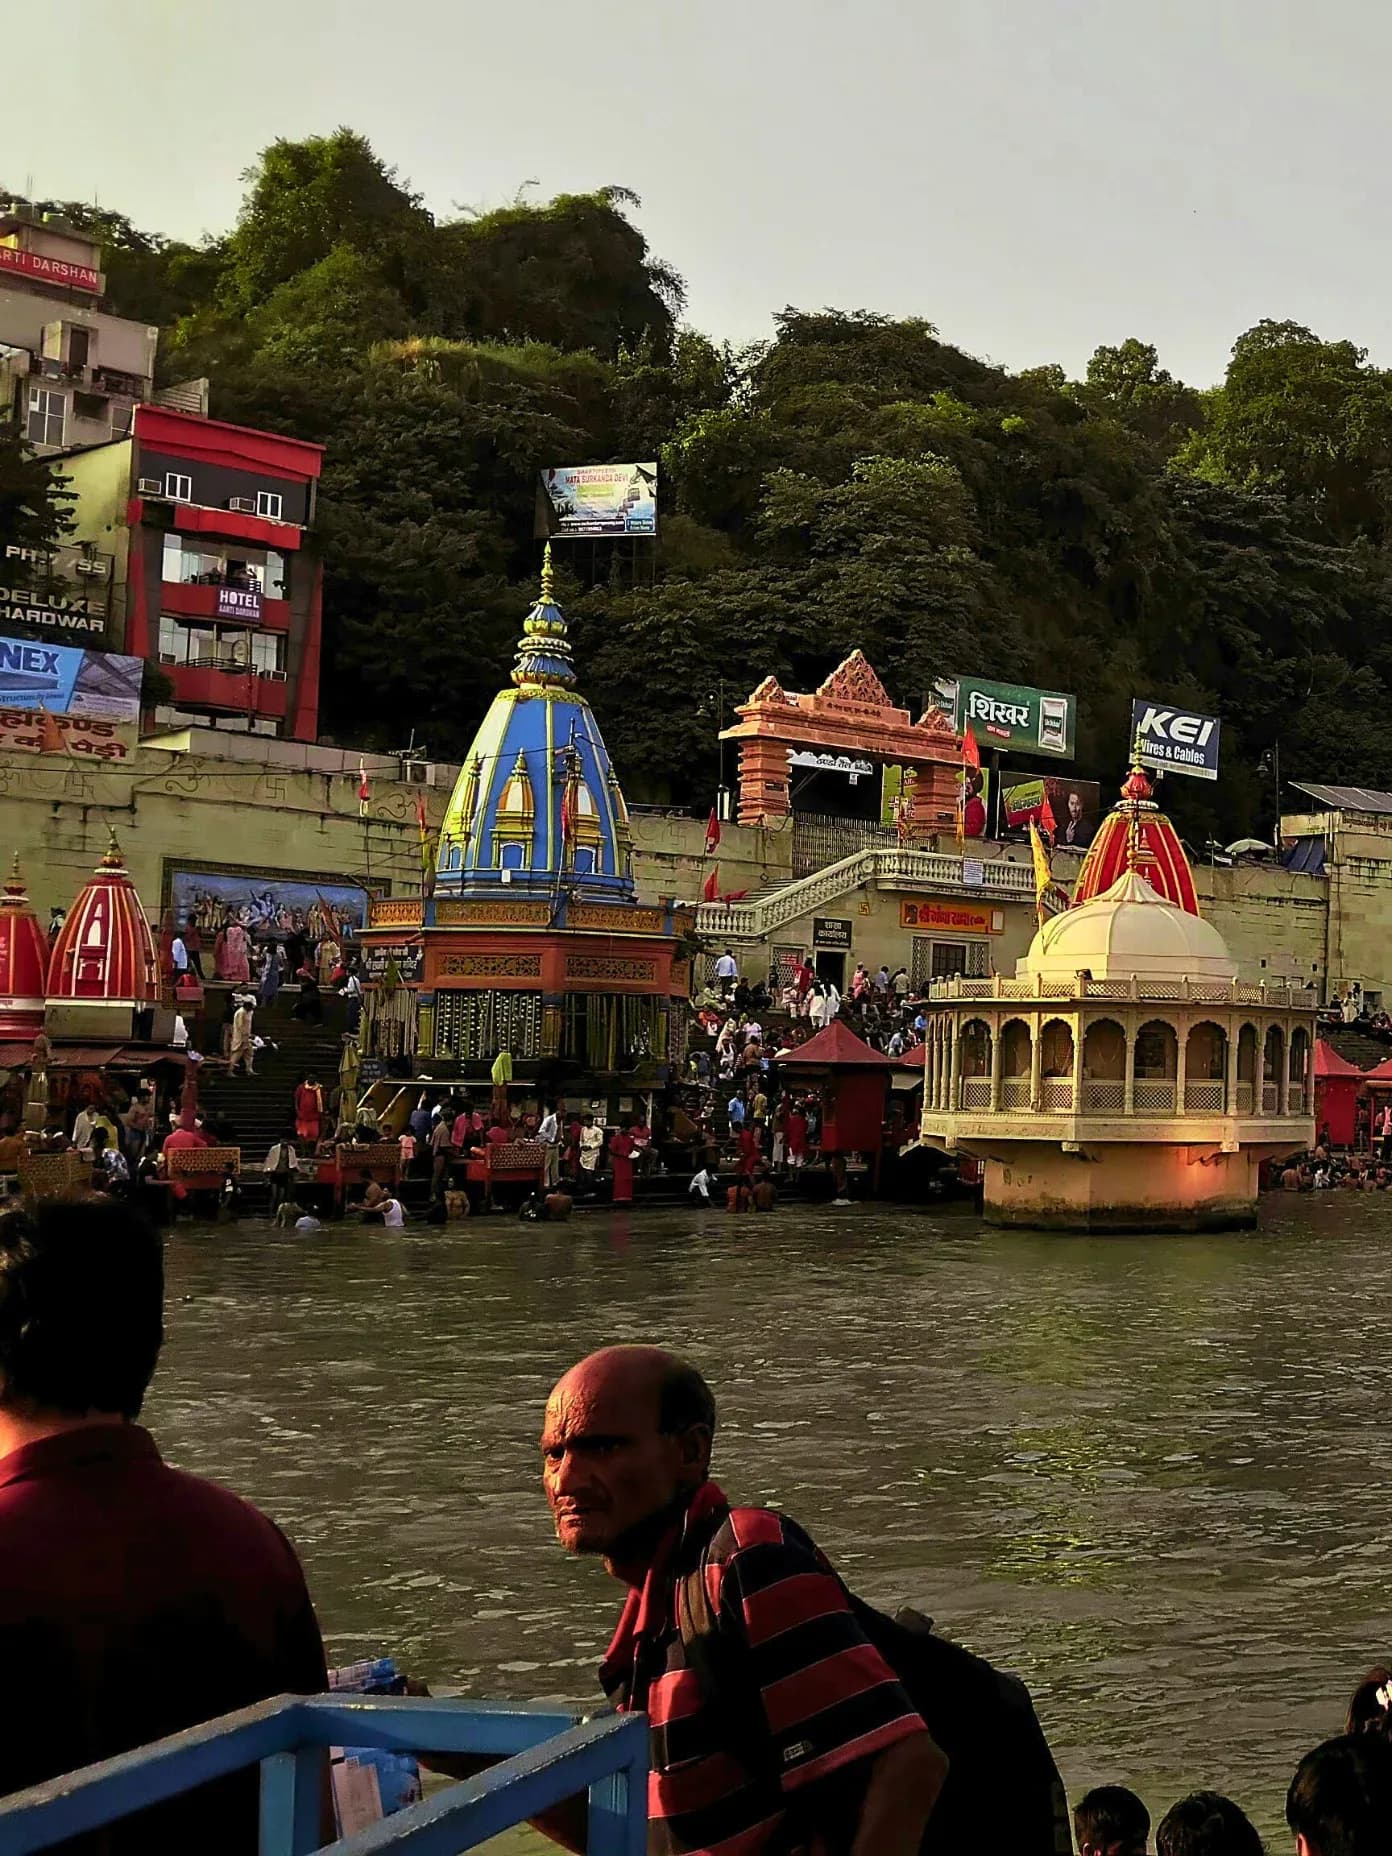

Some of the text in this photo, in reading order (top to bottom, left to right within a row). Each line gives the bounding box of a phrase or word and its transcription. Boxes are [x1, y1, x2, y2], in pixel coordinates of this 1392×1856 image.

[0, 248, 97, 284] RTI DARSHAN
[220, 590, 260, 608] HOTEL
[968, 691, 1030, 728] शिखर
[1139, 707, 1214, 747] KEI
[1165, 746, 1173, 759] &
[1173, 745, 1206, 765] Cables
[824, 921, 842, 930] शाखा
